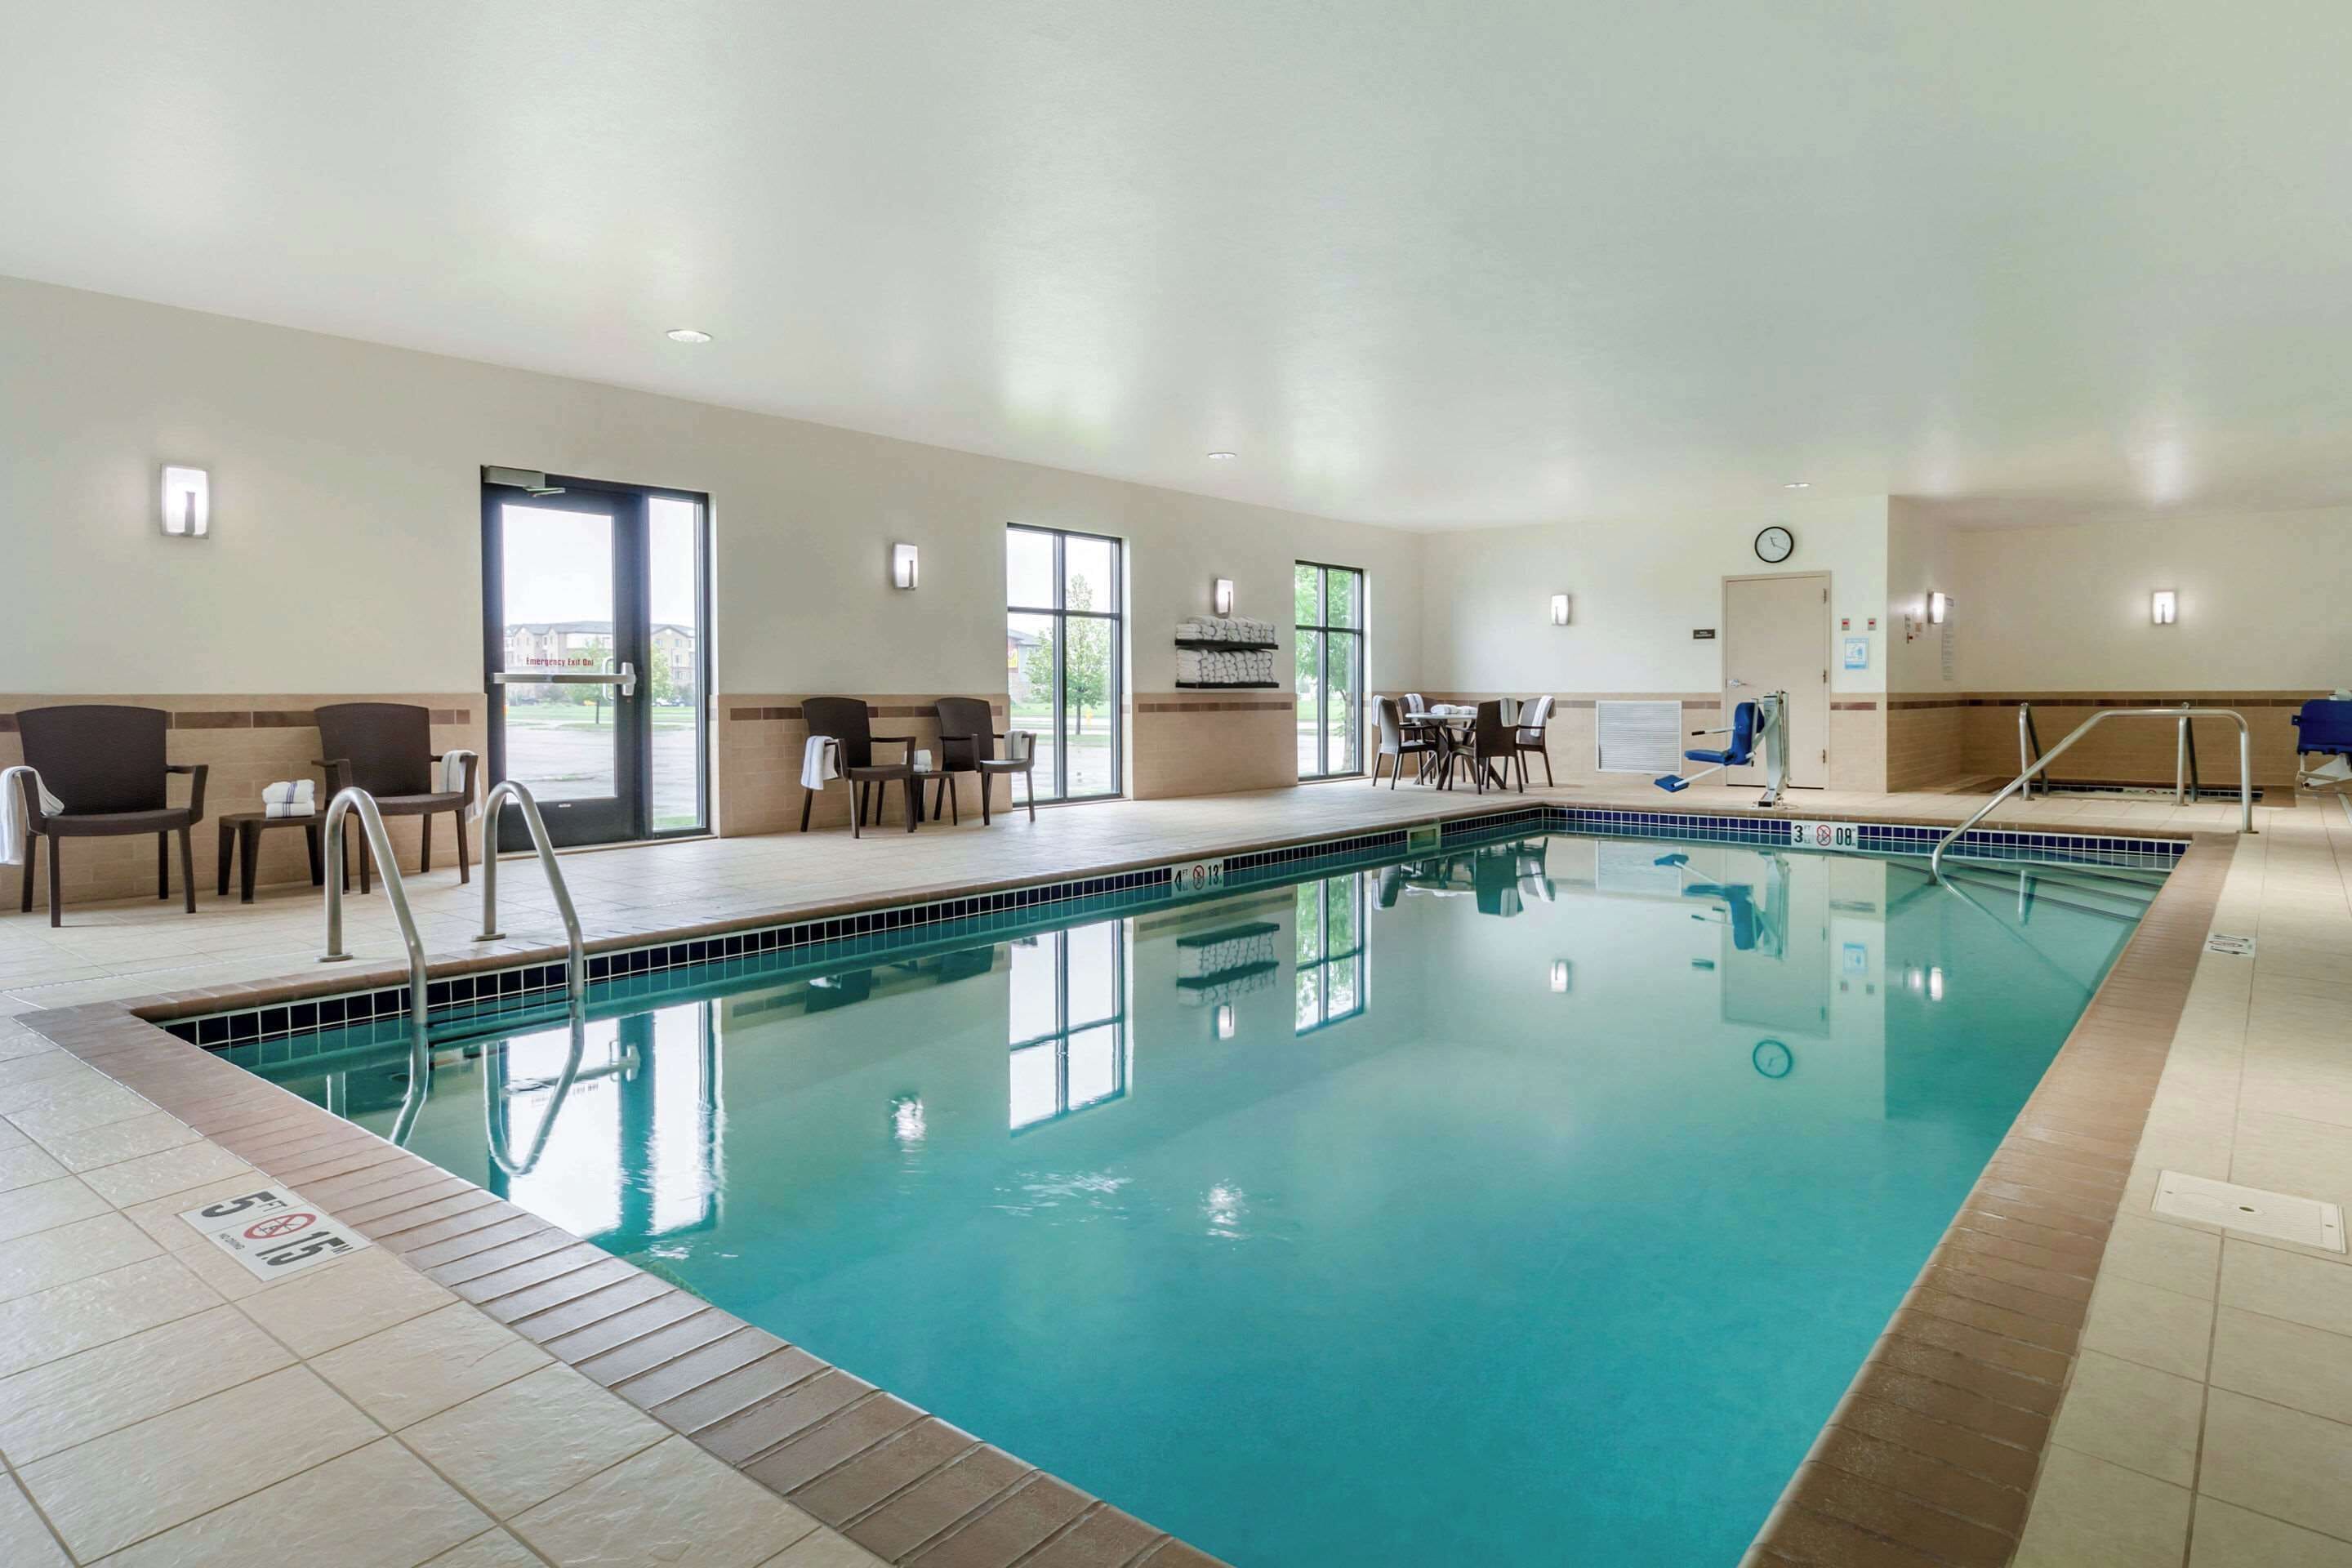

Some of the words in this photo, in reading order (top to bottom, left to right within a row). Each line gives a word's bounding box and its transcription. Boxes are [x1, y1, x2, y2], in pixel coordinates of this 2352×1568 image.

[526, 657, 565, 666] Emergency
[568, 657, 581, 666] Exit
[1174, 870, 1182, 883] 4
[201, 1191, 278, 1218] 5
[257, 1200, 288, 1212] FT
